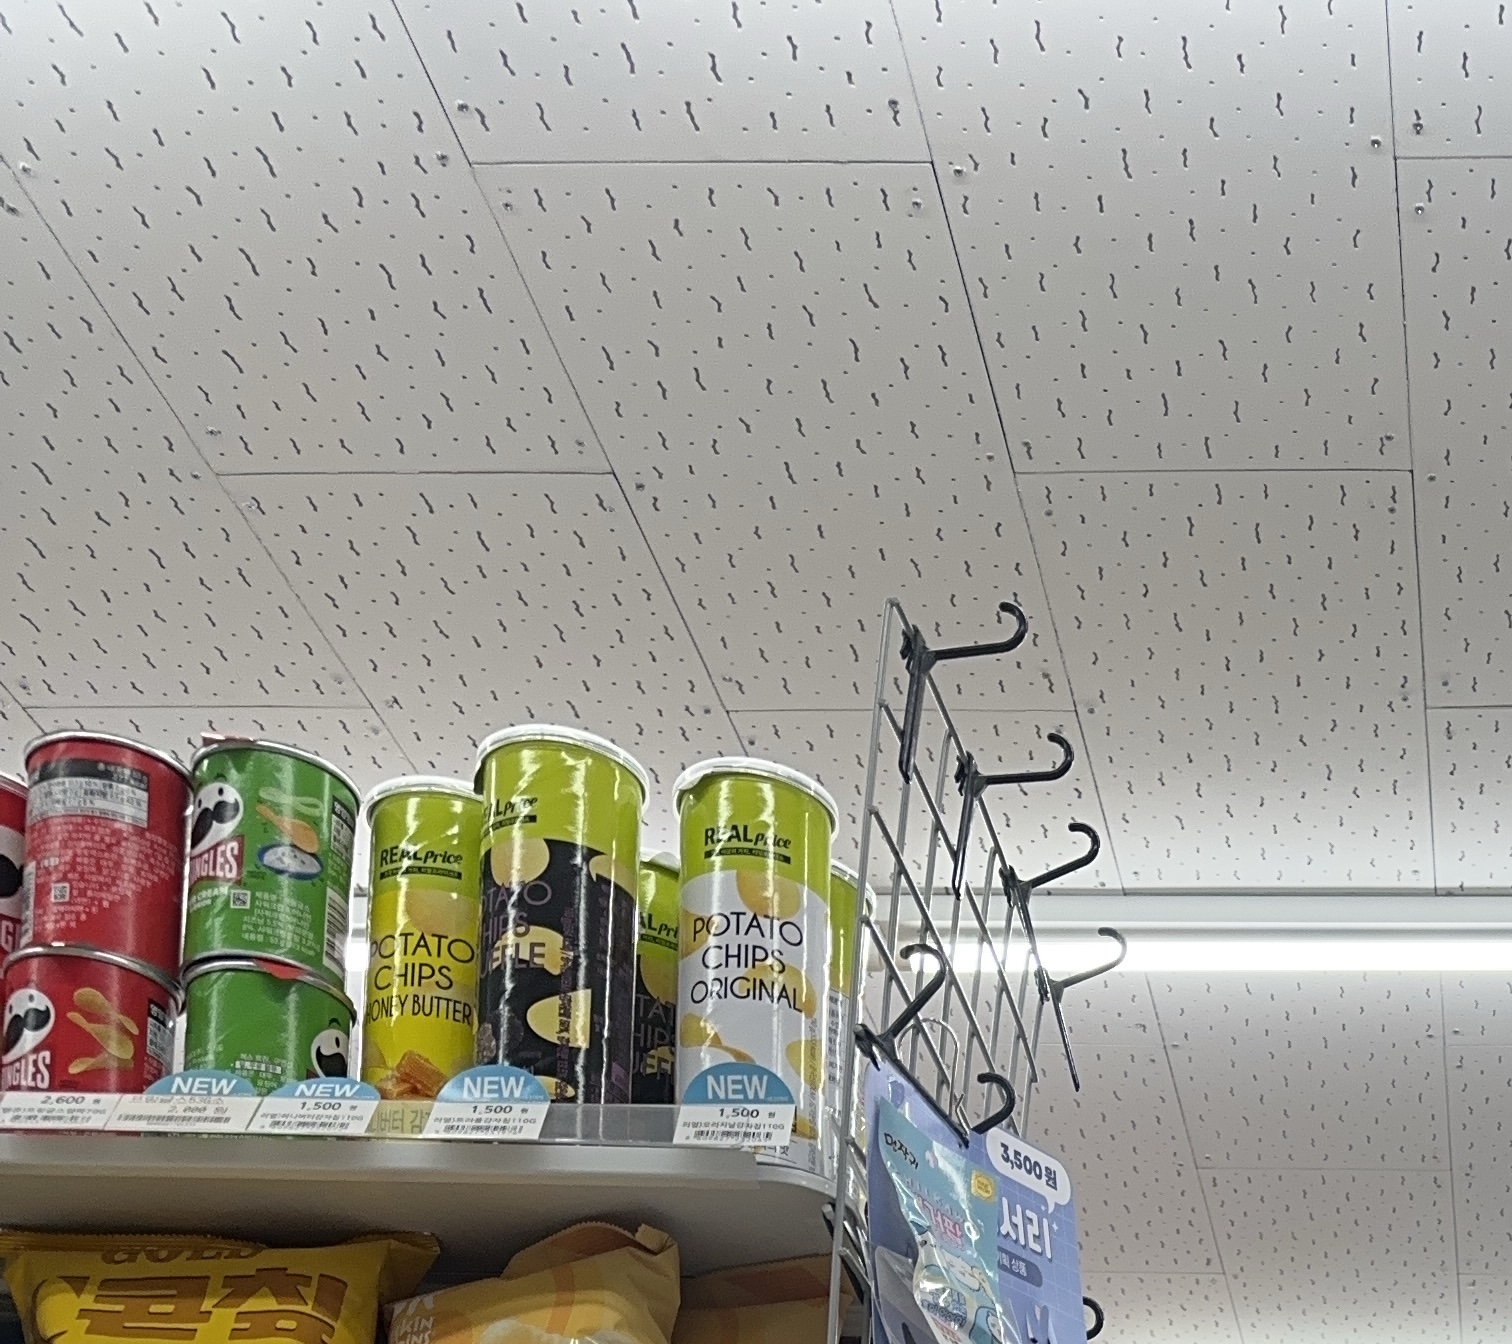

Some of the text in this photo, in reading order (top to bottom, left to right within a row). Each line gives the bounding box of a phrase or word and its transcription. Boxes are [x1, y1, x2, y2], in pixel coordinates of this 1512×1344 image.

[704, 826, 752, 846] REAL
[693, 911, 803, 947] POTATO
[702, 944, 786, 974] CHIPS
[374, 963, 454, 992] CHIPS
[690, 975, 803, 1014] ORIGINAL
[411, 995, 473, 1027] BUTTER
[171, 1077, 237, 1095] NEW
[294, 1083, 361, 1098] NEW
[463, 1076, 525, 1099] NEW
[707, 1075, 768, 1100] NEW
[300, 1101, 342, 1111] 1,500
[472, 1105, 513, 1115] 1,500
[719, 1107, 760, 1119] 1,500
